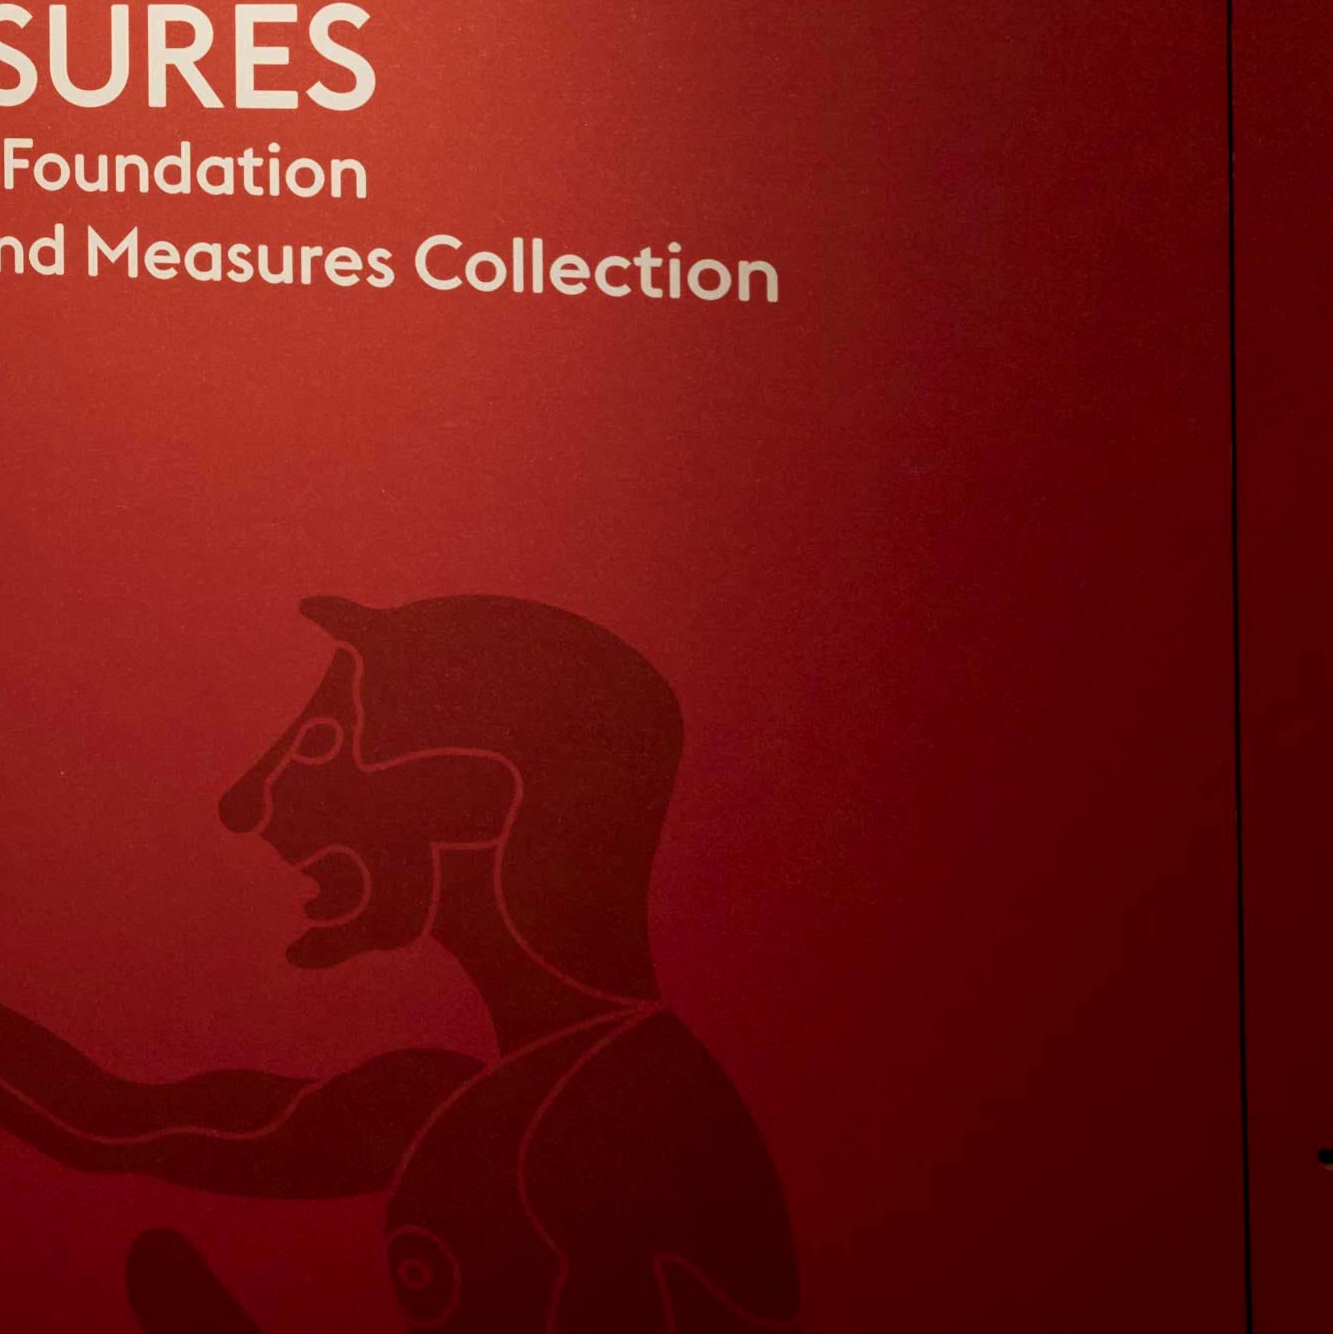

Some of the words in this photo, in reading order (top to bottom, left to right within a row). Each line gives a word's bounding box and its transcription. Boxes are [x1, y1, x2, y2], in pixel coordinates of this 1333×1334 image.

[3, 137, 367, 199] Foundation
[87, 224, 395, 288] Measures
[414, 234, 778, 303] Collection
